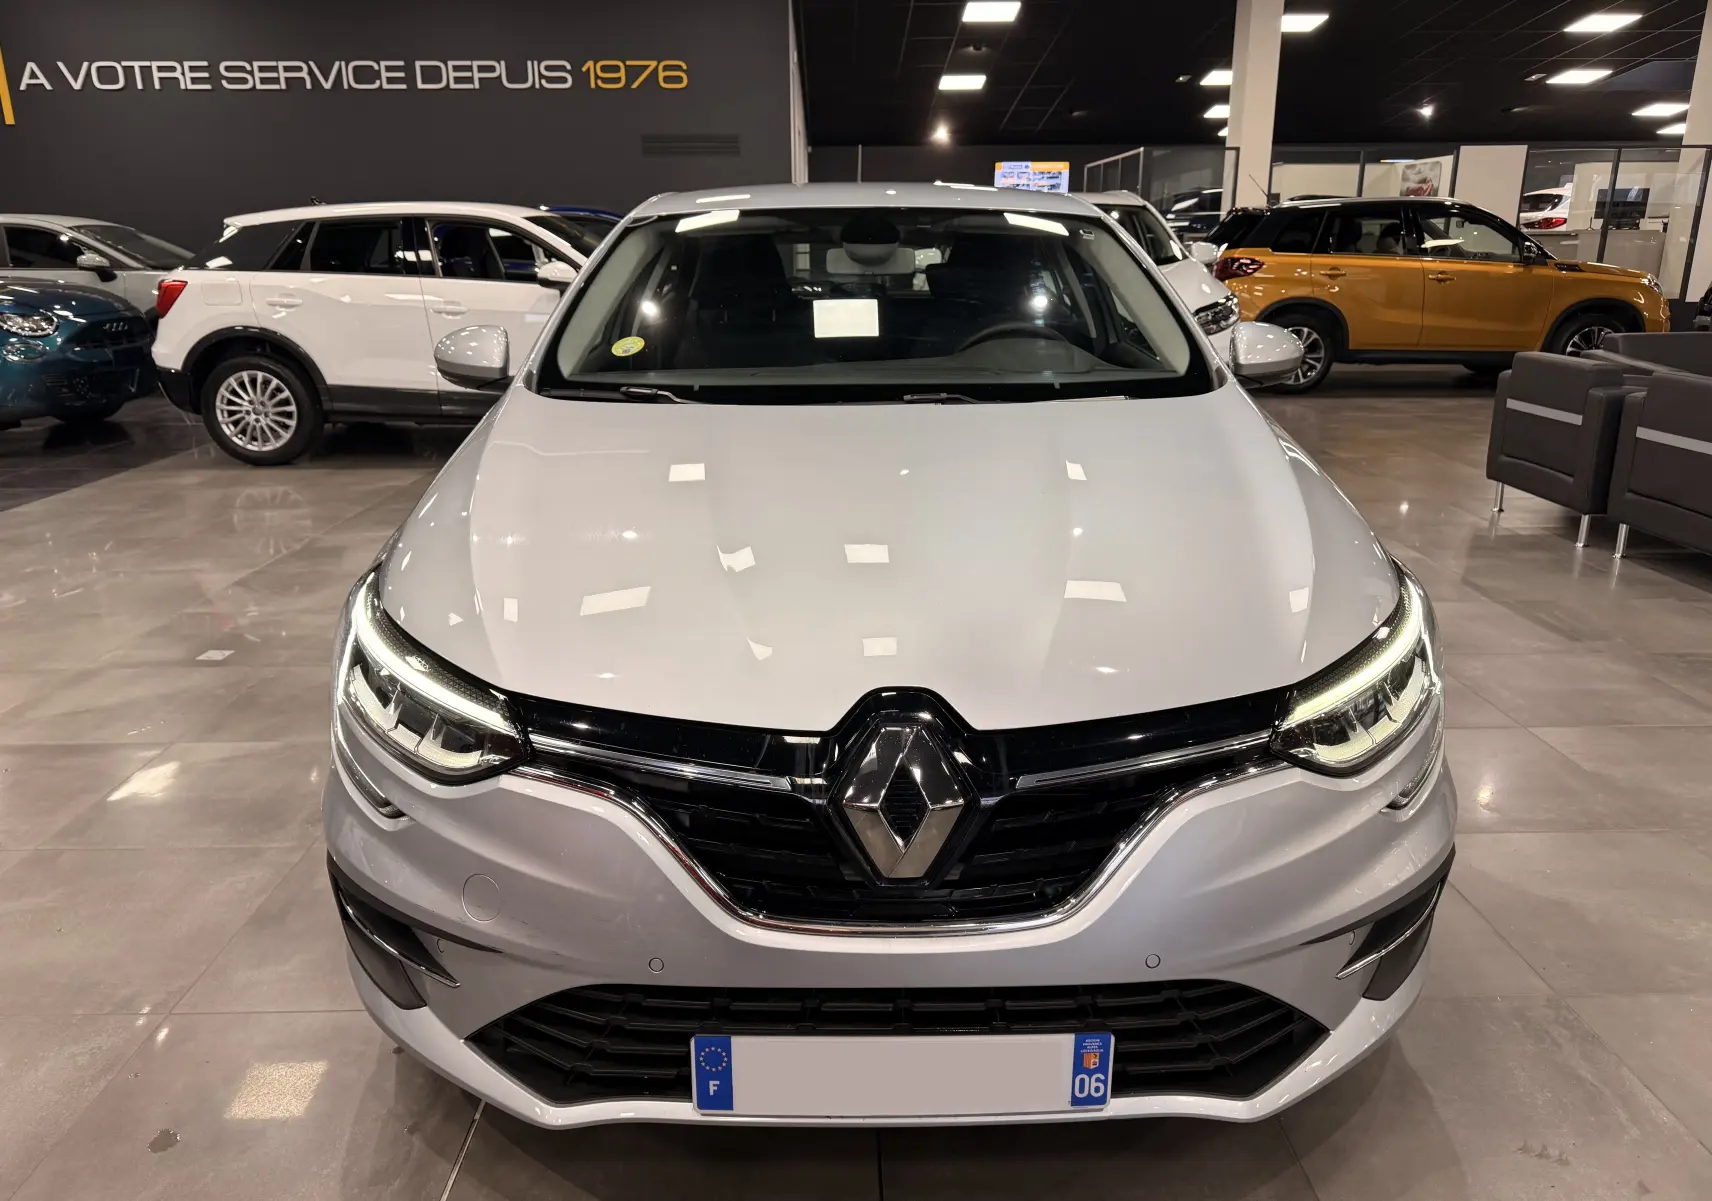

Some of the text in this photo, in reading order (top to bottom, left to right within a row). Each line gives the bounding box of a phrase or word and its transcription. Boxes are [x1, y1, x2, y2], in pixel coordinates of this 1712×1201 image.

[19, 60, 689, 91] A VOTRE SERVICE DEPUIS 1976
[709, 1080, 720, 1096] F
[1074, 1073, 1106, 1097] 06
